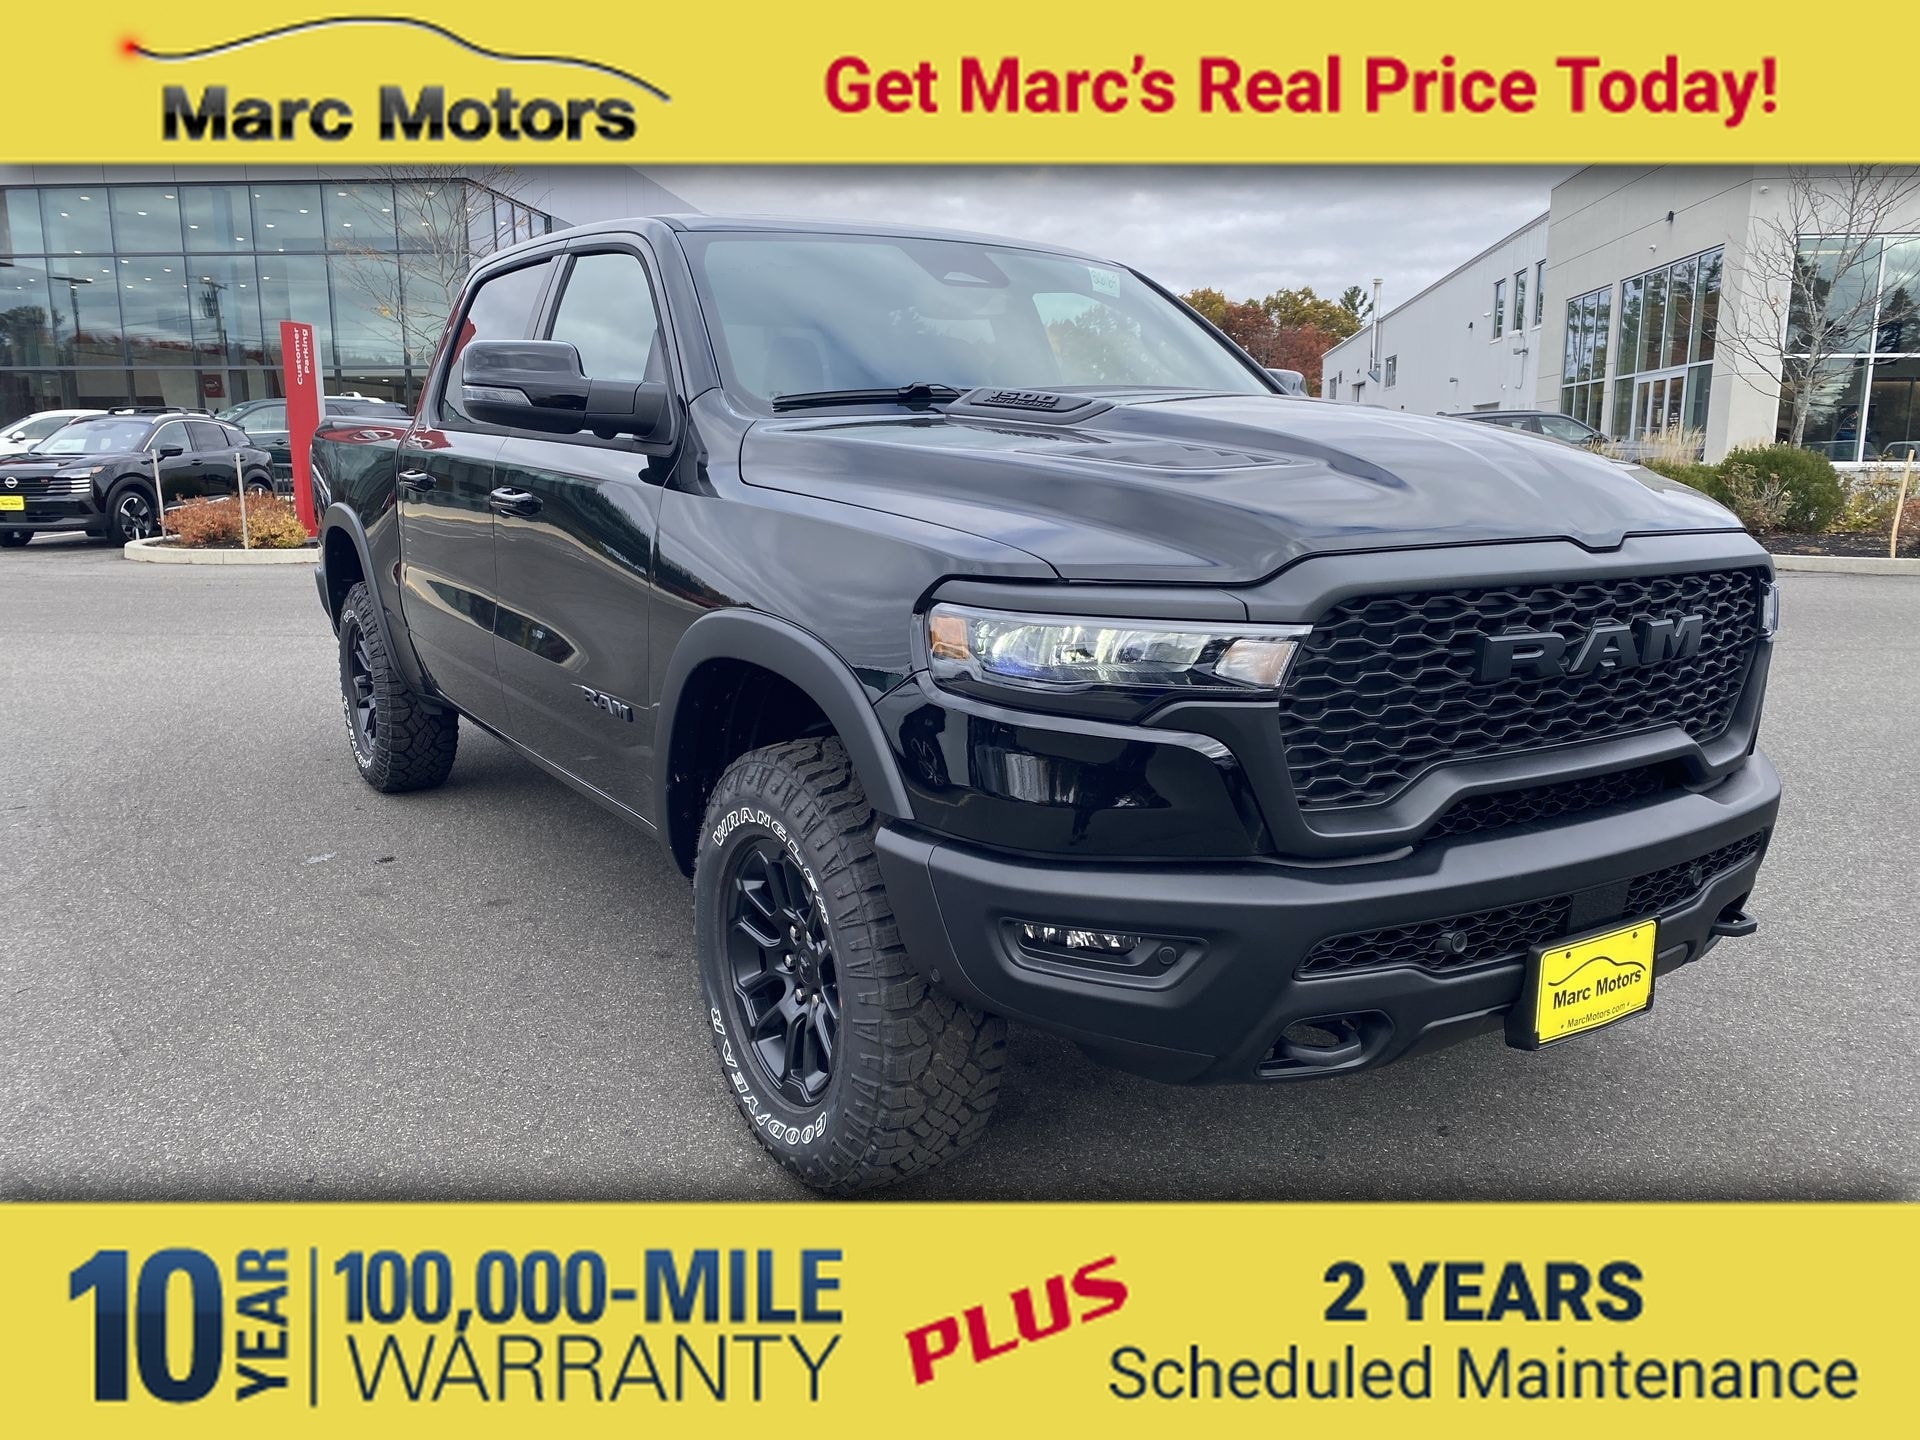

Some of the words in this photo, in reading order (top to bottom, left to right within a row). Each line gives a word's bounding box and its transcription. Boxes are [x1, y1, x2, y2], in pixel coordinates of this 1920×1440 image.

[294, 327, 303, 385] Customer
[302, 328, 310, 374] Parking
[991, 391, 1060, 405] 1500
[1481, 614, 1703, 681] RAM
[581, 685, 634, 722] RAM
[712, 807, 829, 925] WRANGLER
[1553, 986, 1591, 1010] Marc
[1595, 969, 1642, 997] Motors
[1566, 1003, 1627, 1029] MarcMotors.com
[711, 1007, 827, 1145] GOODYEAR
